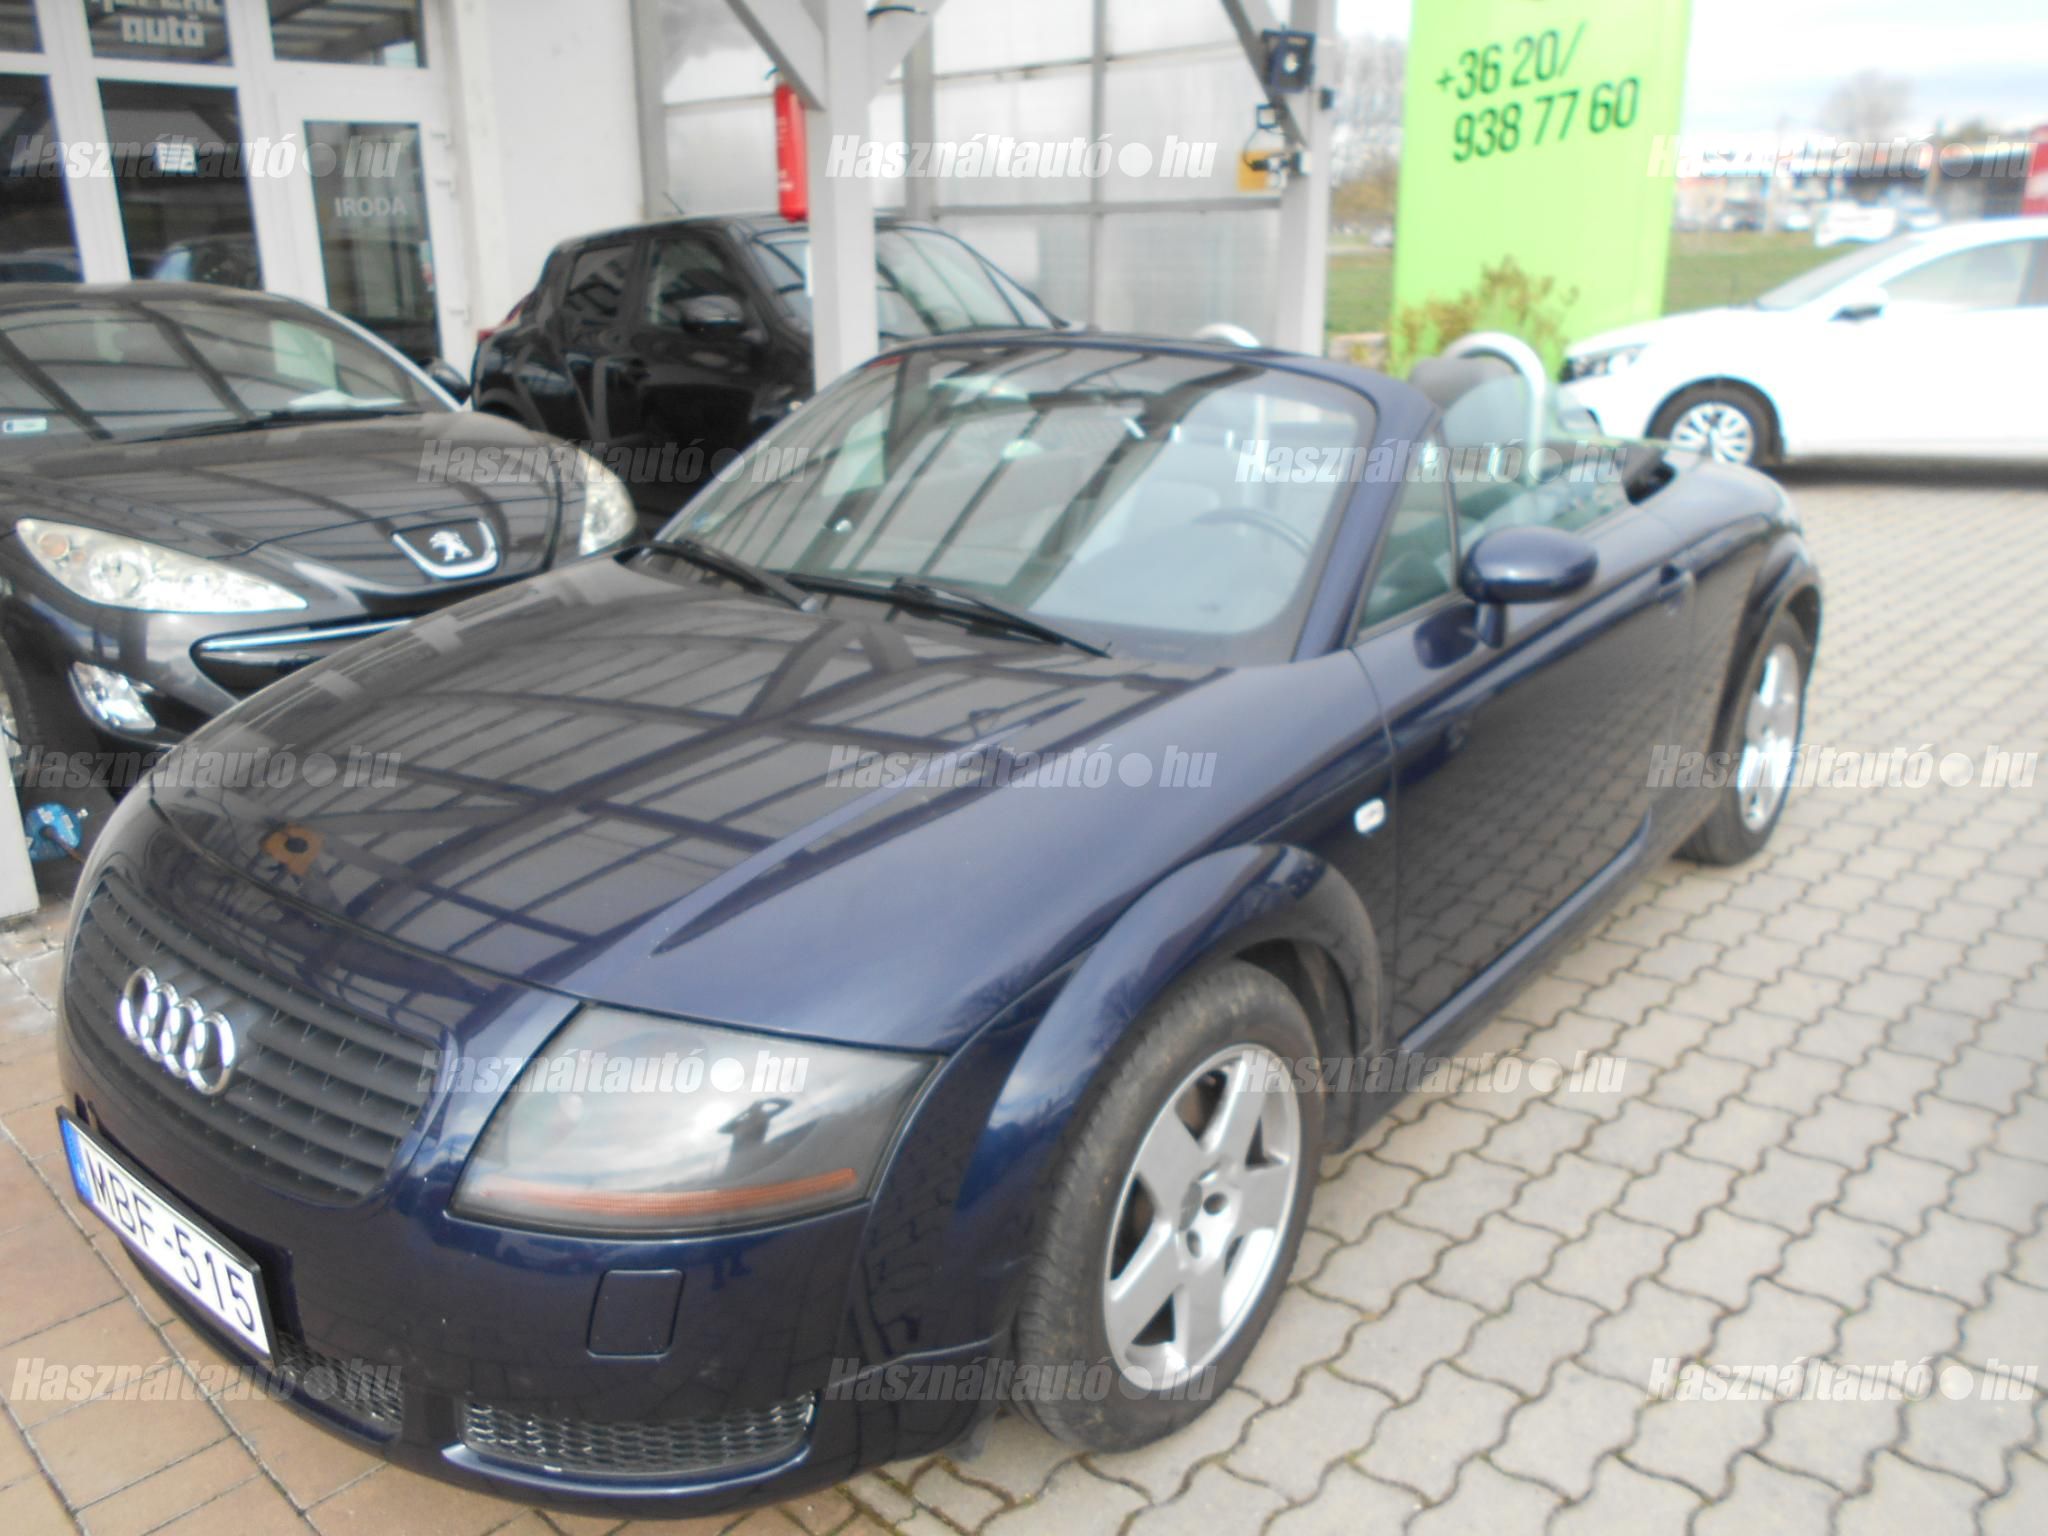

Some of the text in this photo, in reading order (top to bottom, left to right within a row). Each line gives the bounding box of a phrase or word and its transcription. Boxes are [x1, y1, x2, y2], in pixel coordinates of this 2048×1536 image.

[1435, 43, 1502, 100] +36
[1453, 76, 1640, 162] 938 77 60
[334, 197, 407, 217] IRODA
[83, 1148, 255, 1333] MBF-515
